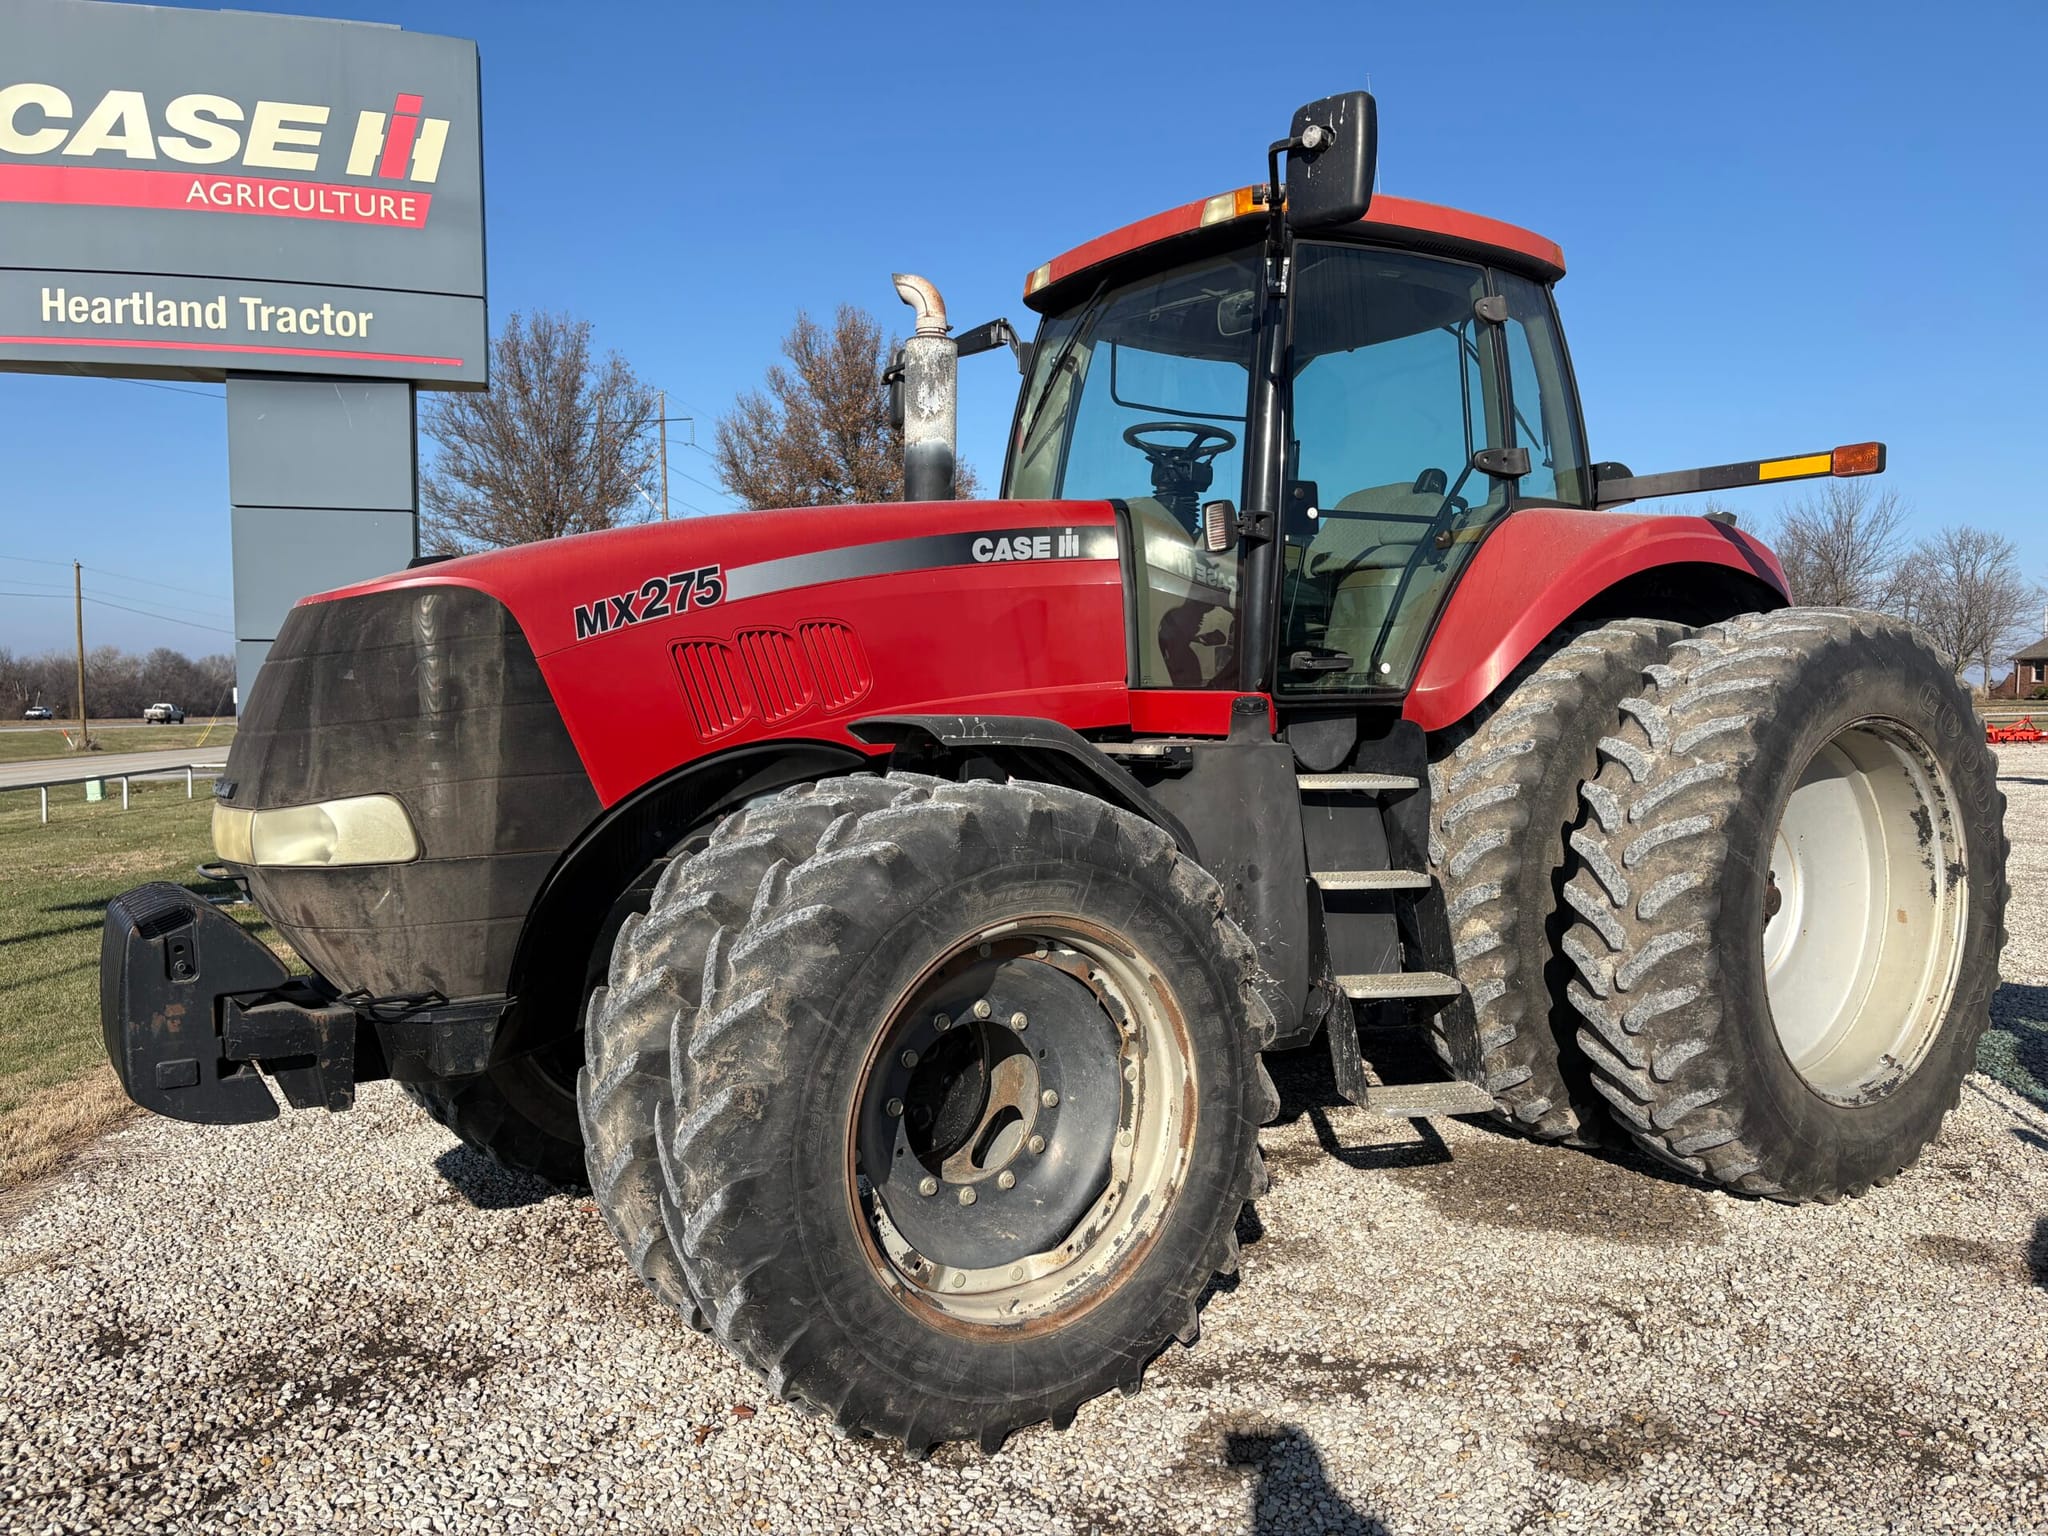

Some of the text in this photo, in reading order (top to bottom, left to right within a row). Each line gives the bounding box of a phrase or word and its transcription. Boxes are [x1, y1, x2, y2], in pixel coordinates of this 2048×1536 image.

[0, 83, 330, 171] CASE
[186, 181, 417, 221] AGRICULTURE
[41, 287, 373, 338] Heartland Tractor
[971, 536, 1050, 562] CASE
[573, 563, 723, 641] MX275
